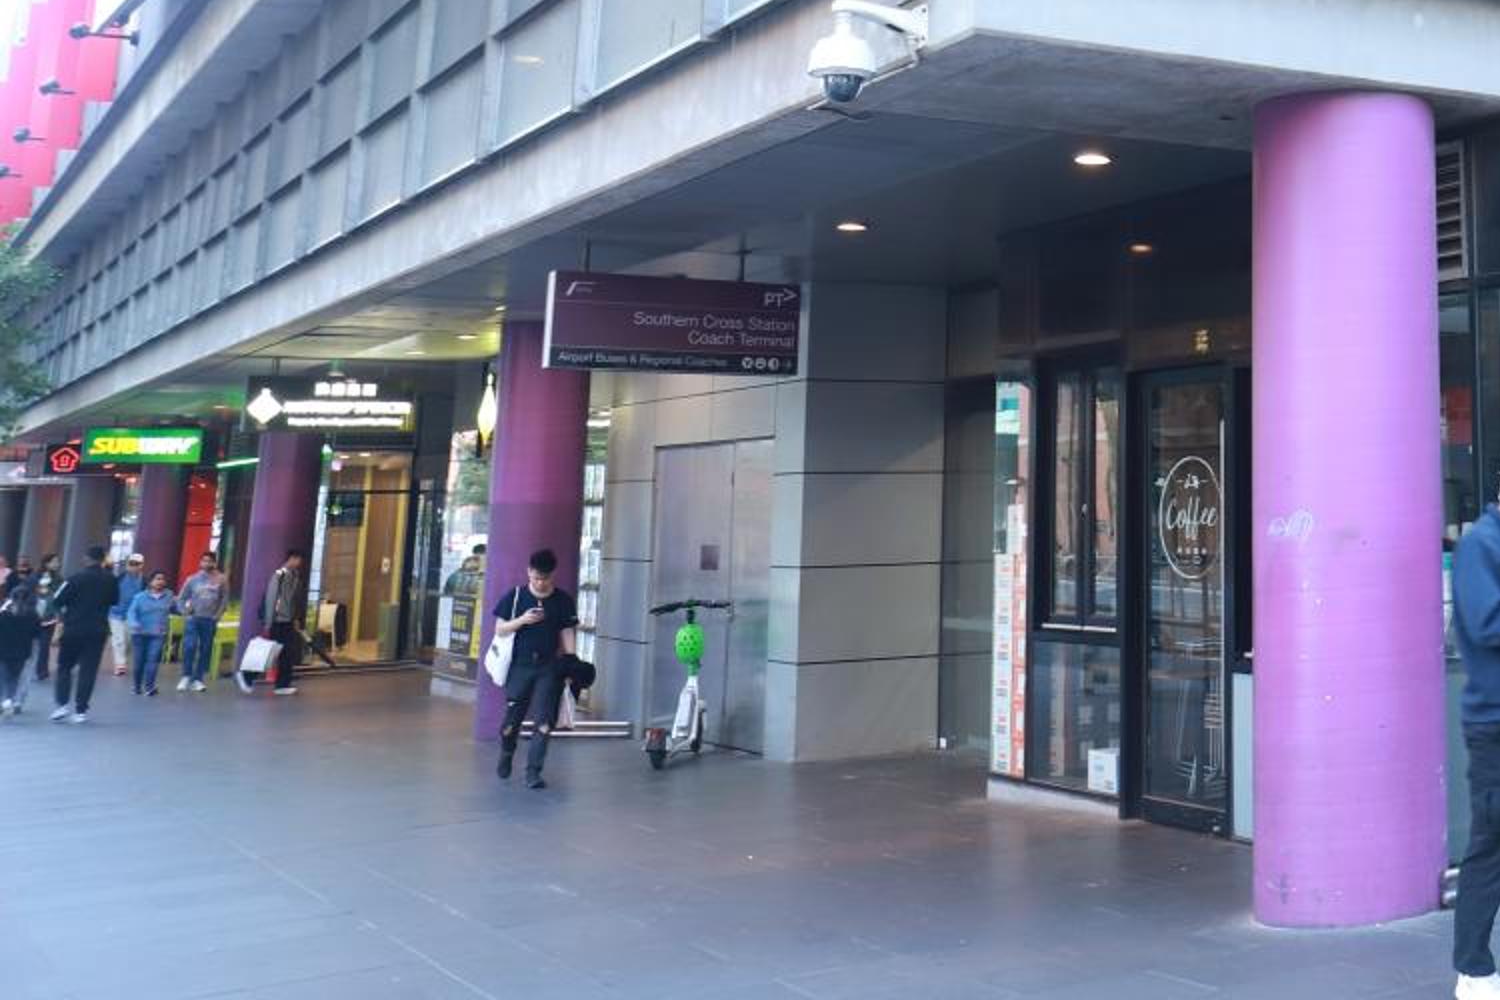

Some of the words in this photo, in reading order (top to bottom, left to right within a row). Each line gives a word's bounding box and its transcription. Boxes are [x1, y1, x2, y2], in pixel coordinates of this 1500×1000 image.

[633, 311, 700, 329] Southern
[703, 314, 745, 331] Cross
[749, 316, 795, 332] Station
[687, 329, 736, 346] Coach
[739, 333, 795, 348] Terminal
[89, 437, 199, 456] SUBWAY
[1166, 496, 1218, 541] Coffee
